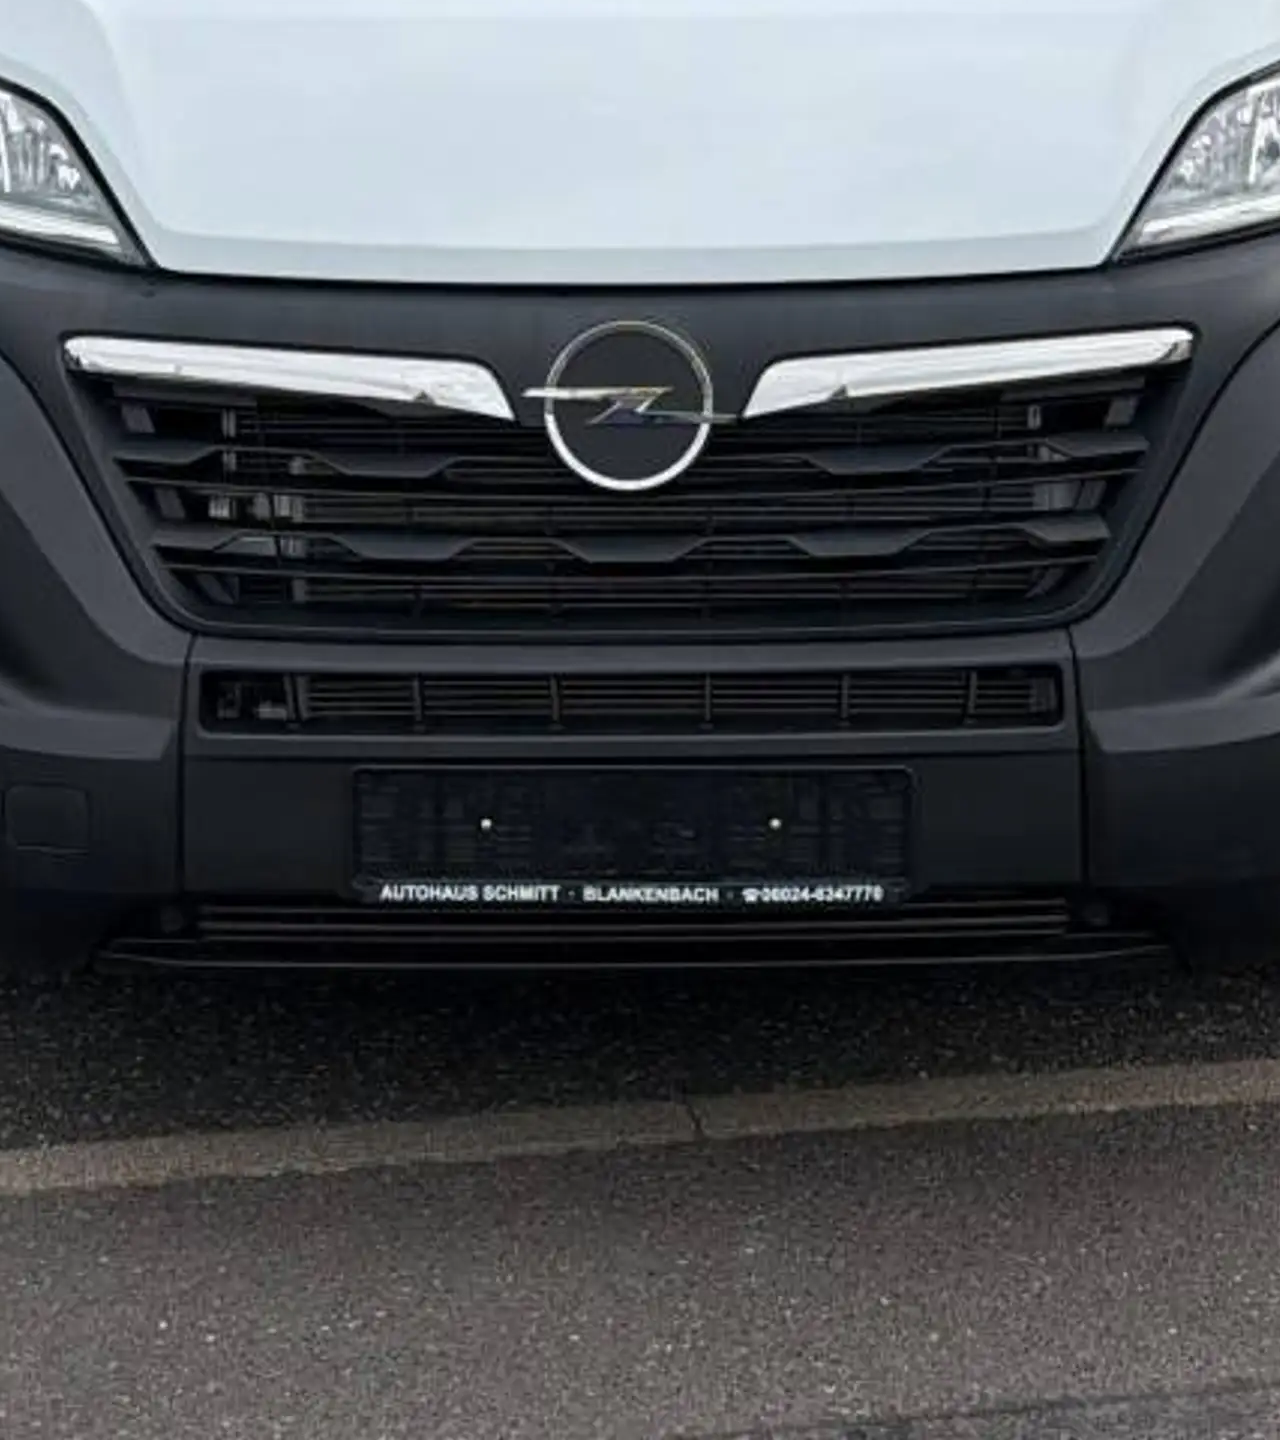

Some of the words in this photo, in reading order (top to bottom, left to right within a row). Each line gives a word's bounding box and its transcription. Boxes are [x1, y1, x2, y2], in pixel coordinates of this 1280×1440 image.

[380, 884, 478, 902] AUTOHAUS
[483, 884, 561, 902] SCHMITT
[583, 885, 720, 903] BLANKENBACH
